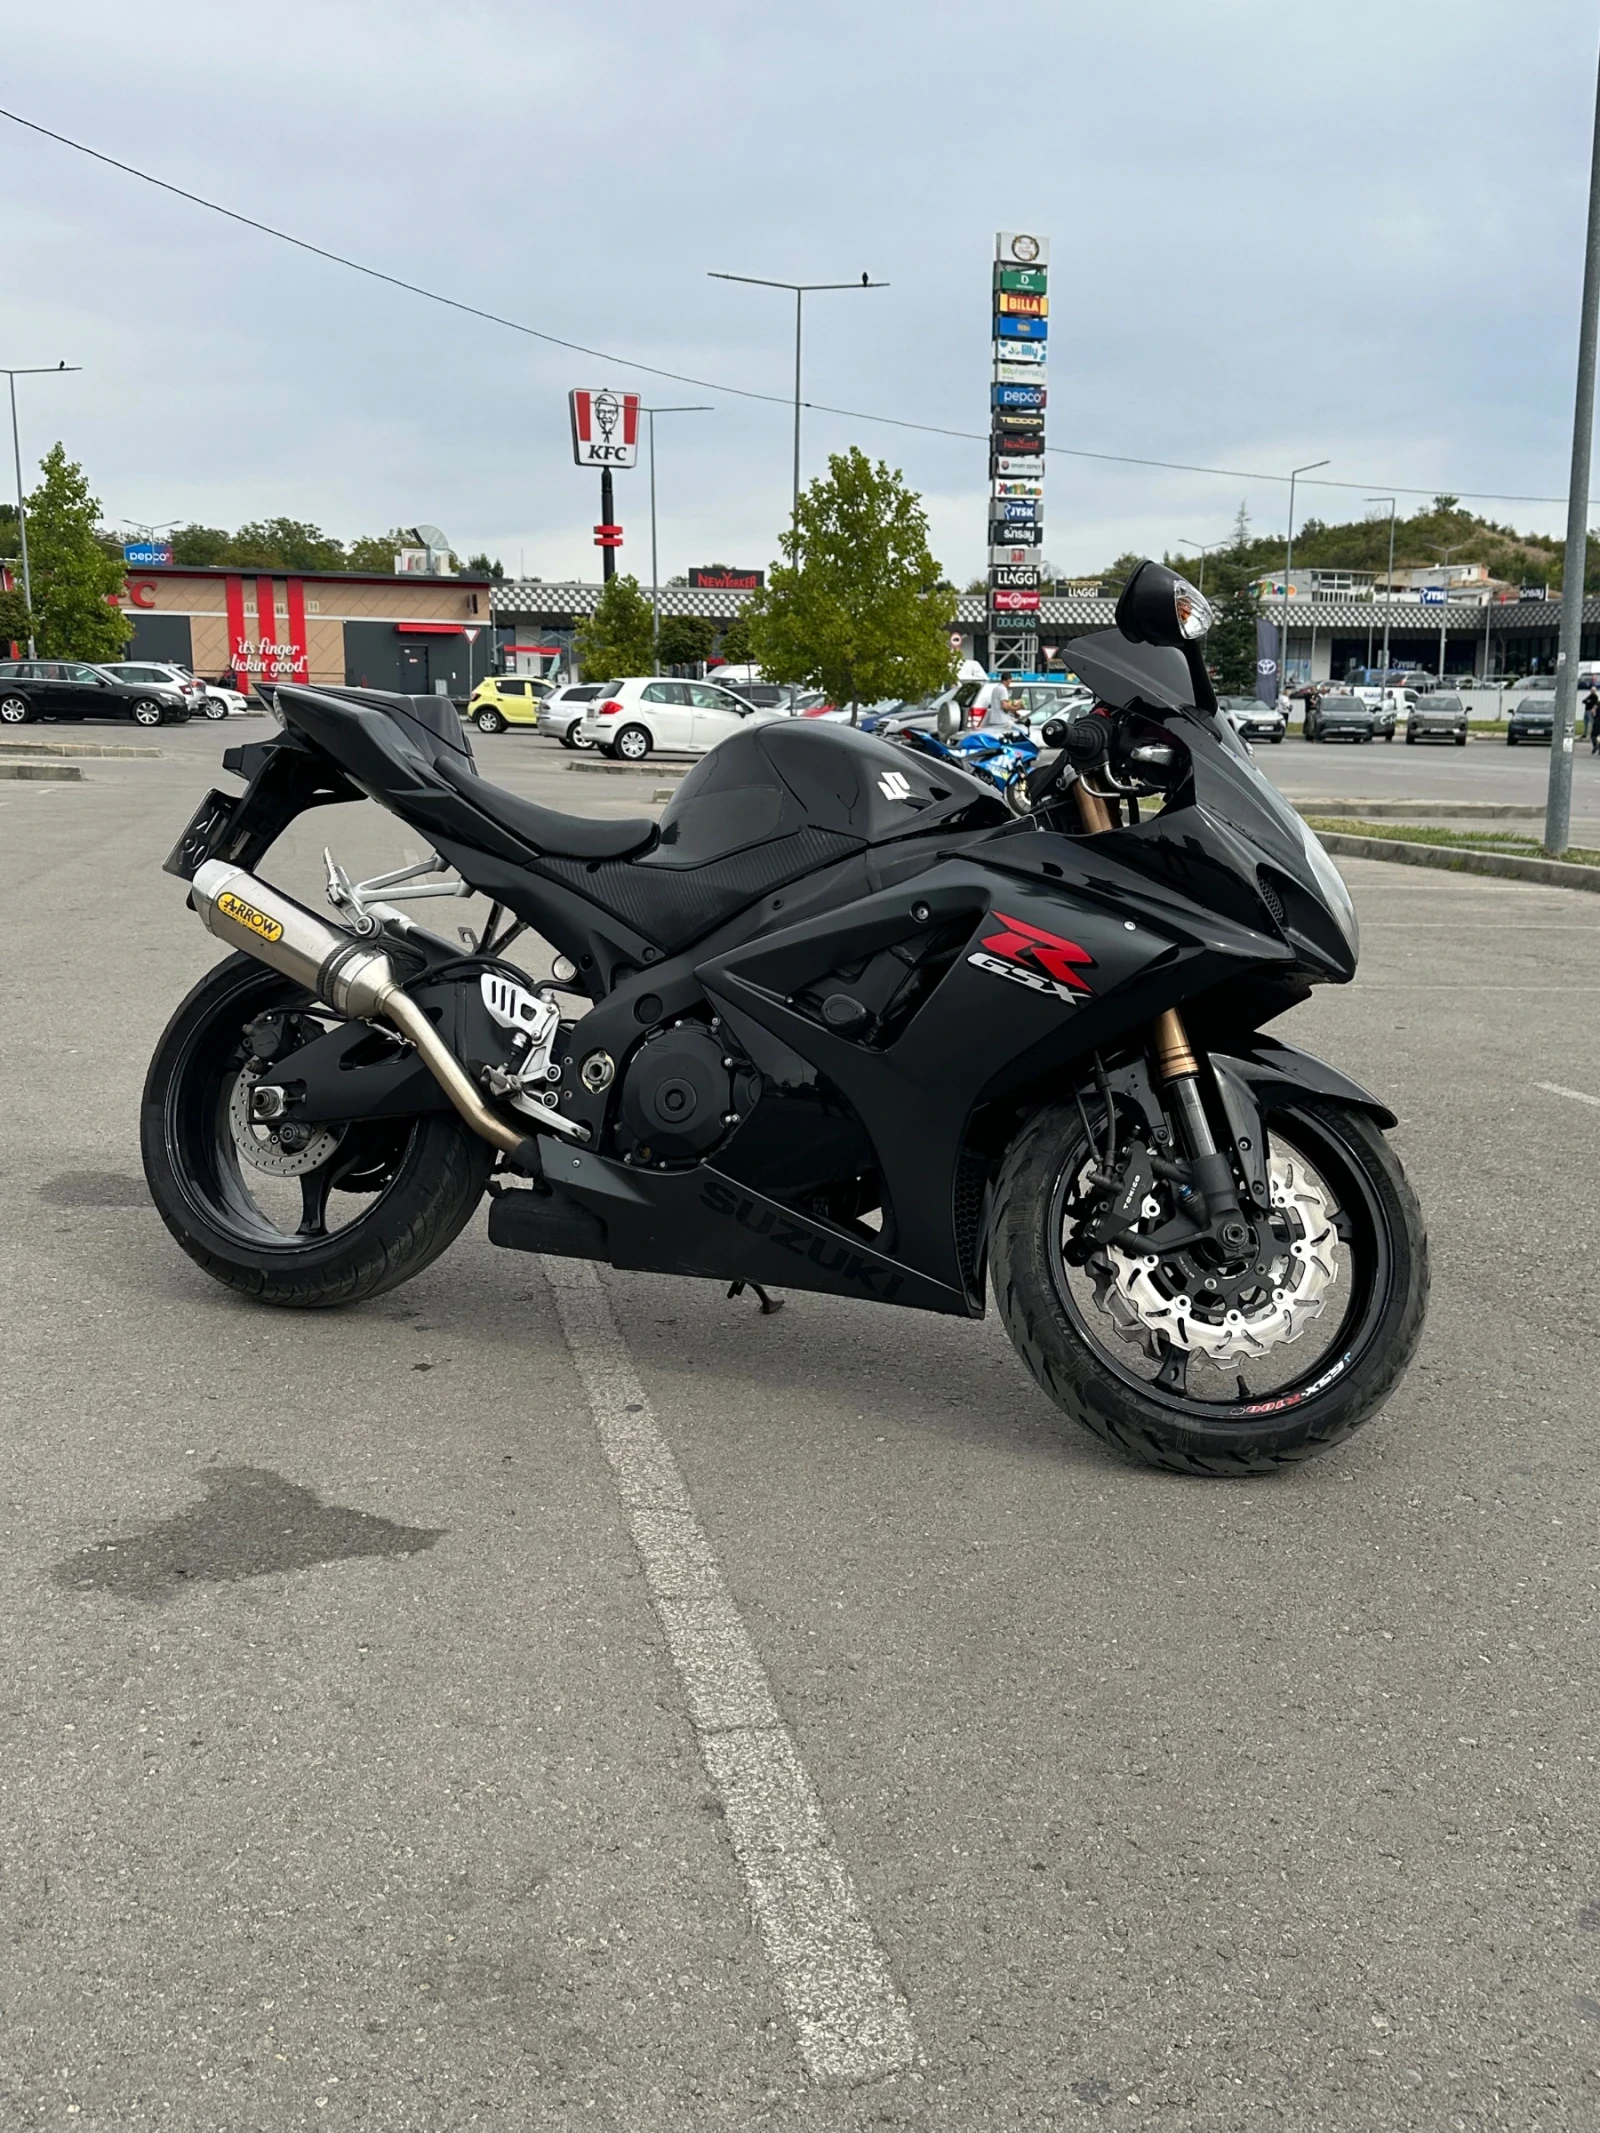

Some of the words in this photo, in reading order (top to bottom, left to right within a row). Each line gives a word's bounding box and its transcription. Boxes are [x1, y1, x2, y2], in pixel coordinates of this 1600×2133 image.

[1009, 298, 1039, 312] BILLA
[1004, 390, 1041, 403] pepco
[588, 444, 627, 461] KFC
[1010, 506, 1034, 517] JYSK
[1003, 527, 1035, 542] sinsay
[129, 552, 167, 565] pepco
[996, 617, 1036, 628] DOUGLAS
[258, 637, 300, 660] finger
[222, 898, 279, 935] ARROW
[1122, 1174, 1141, 1210] TOKICO
[700, 1181, 905, 1299] SUZUKI
